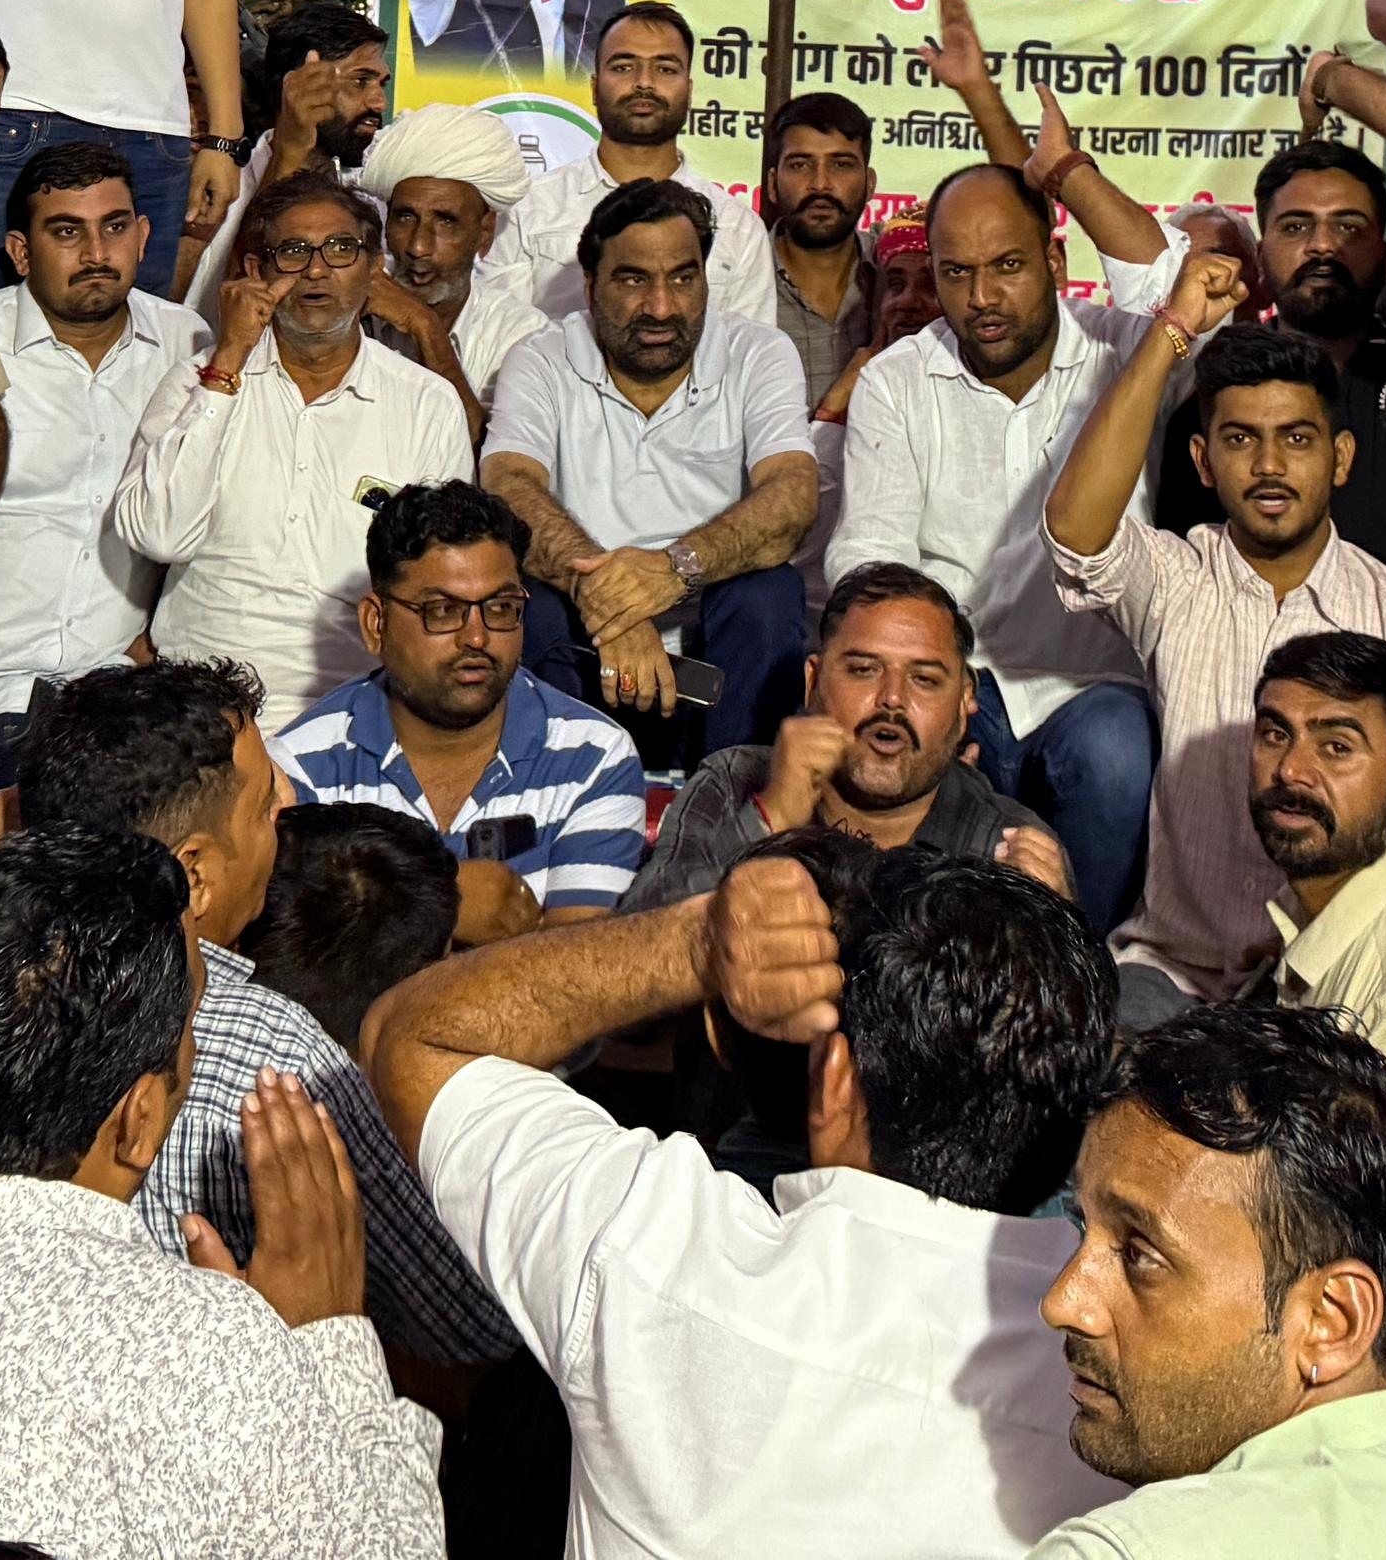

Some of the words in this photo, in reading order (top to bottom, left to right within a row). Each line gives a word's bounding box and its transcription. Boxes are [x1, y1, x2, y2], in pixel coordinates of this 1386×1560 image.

[700, 26, 753, 80] की
[844, 33, 898, 87] को
[1013, 39, 1126, 96] पिछले
[1134, 55, 1208, 97] 100
[1217, 44, 1312, 98] दिनों
[1086, 126, 1161, 157] धरना
[1165, 128, 1267, 158] लगातार
